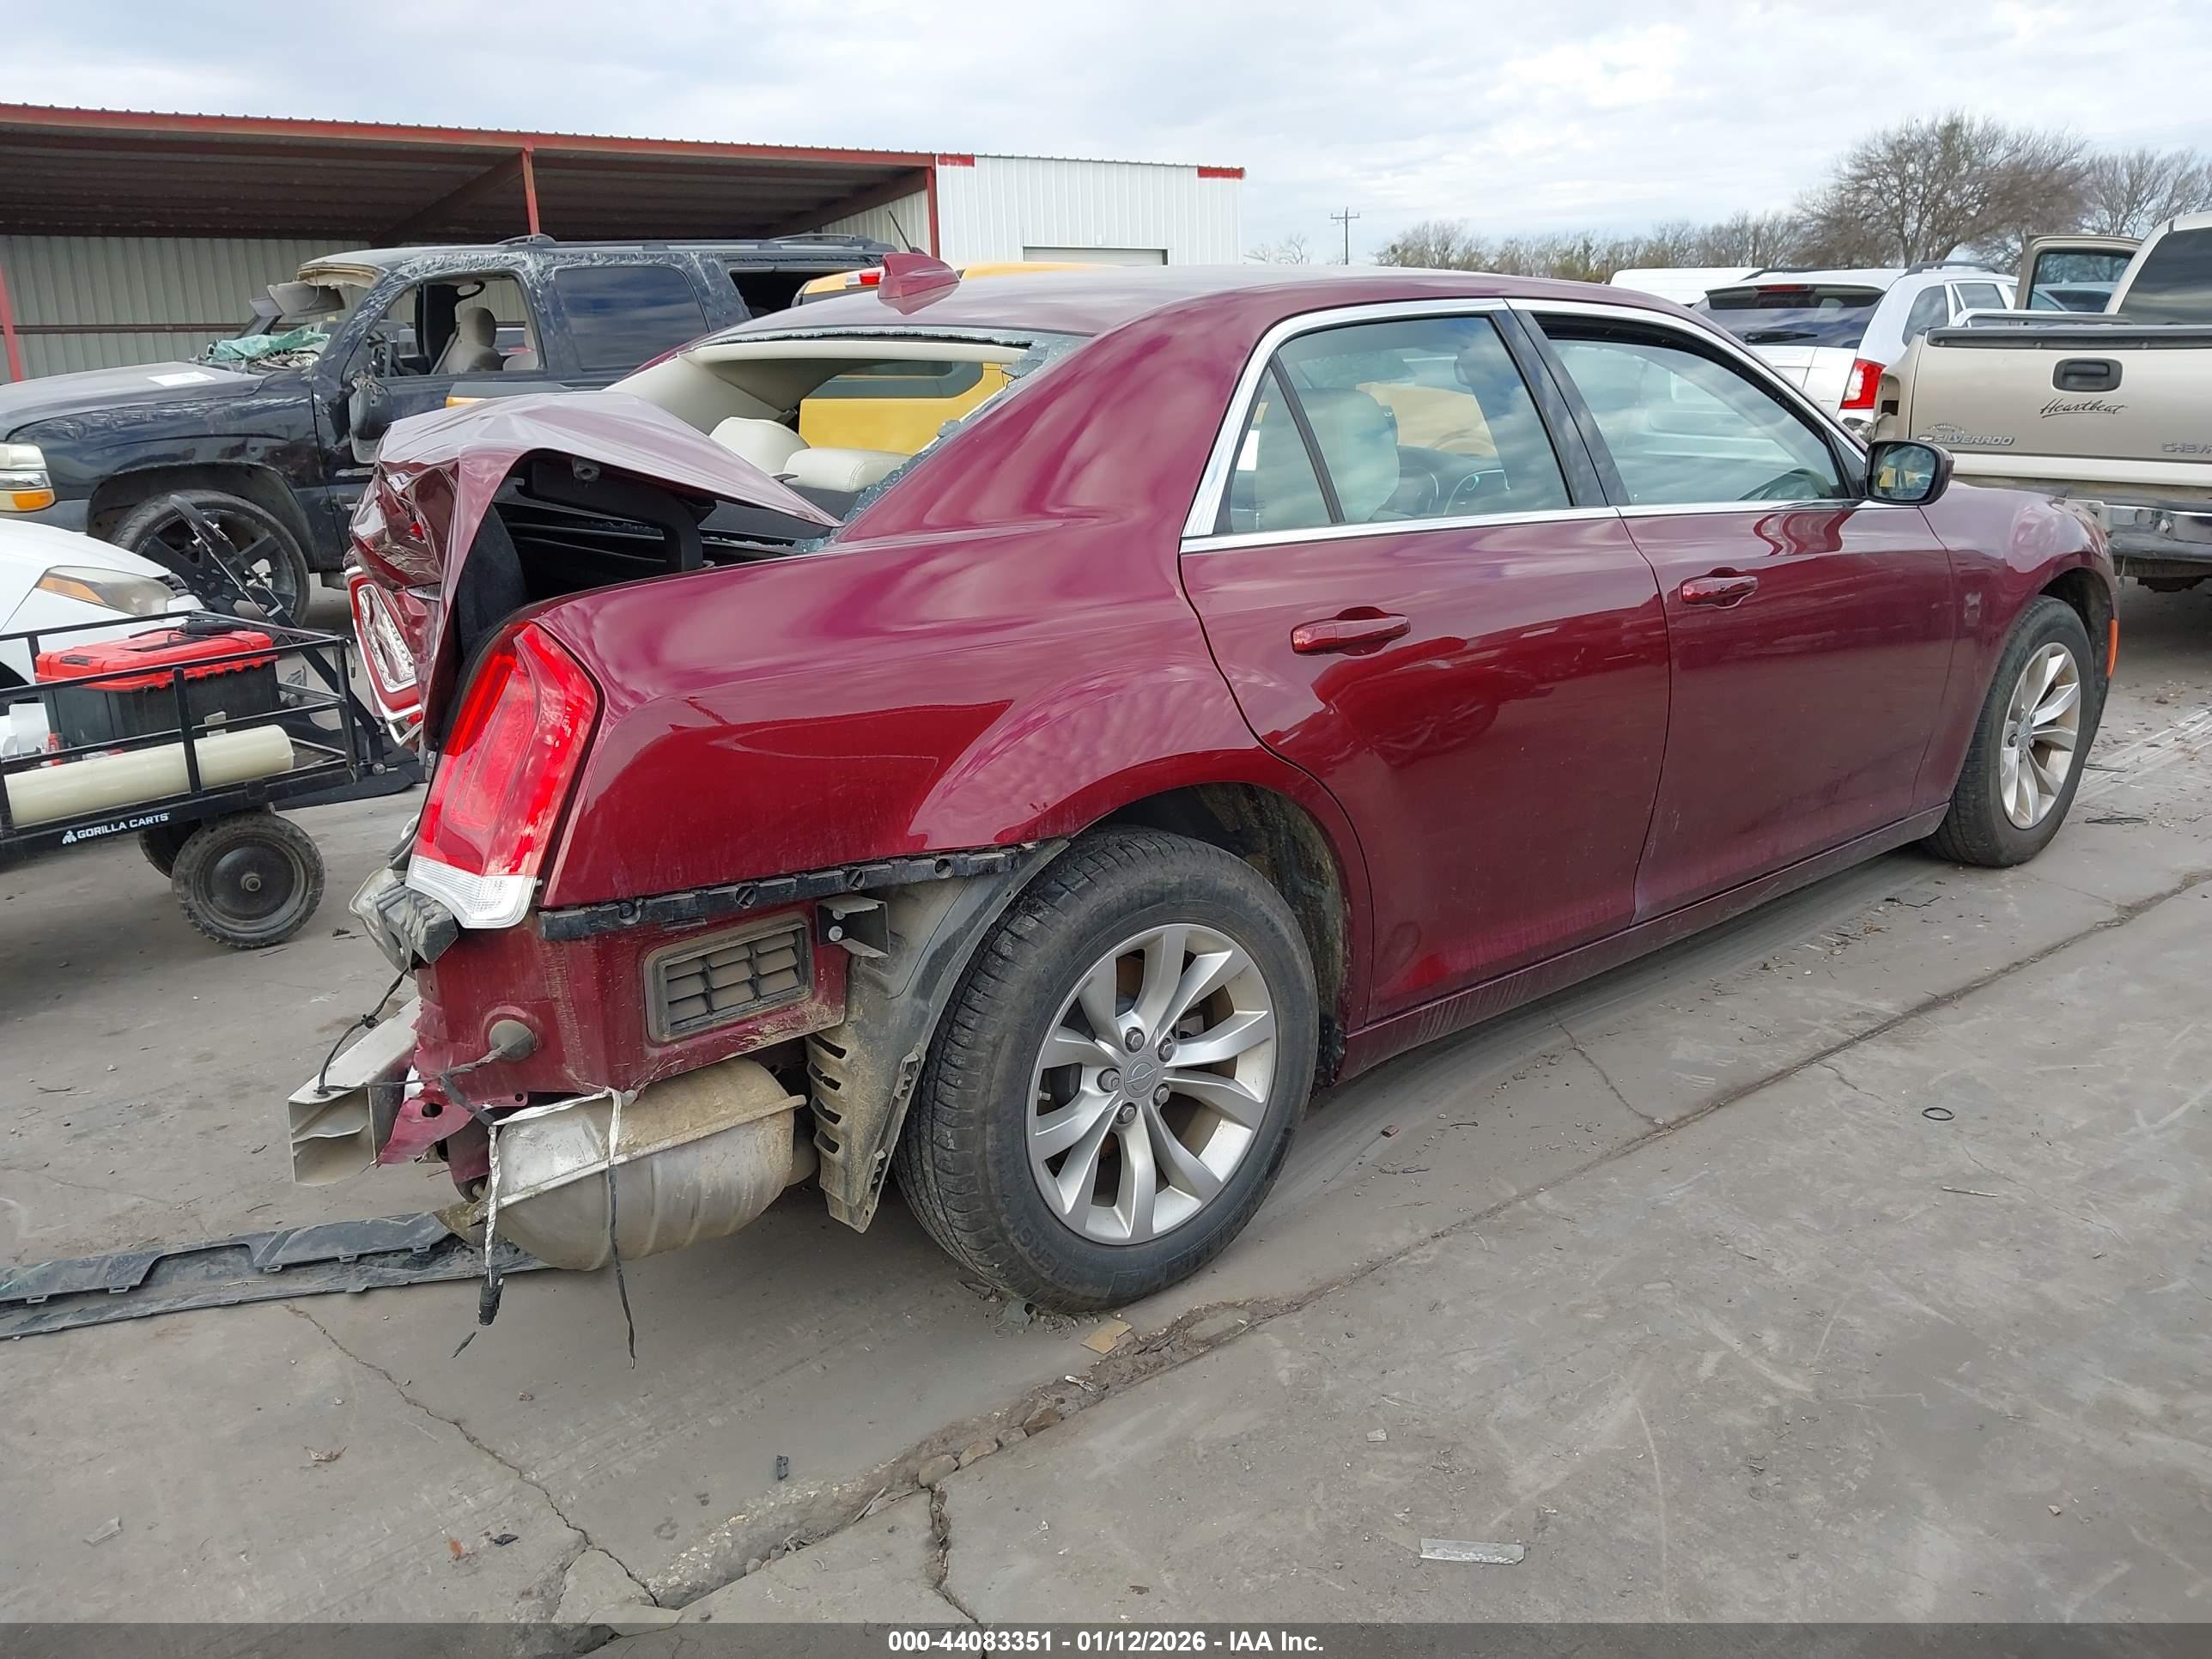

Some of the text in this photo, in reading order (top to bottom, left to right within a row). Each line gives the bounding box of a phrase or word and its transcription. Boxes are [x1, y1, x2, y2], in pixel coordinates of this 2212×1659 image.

[2039, 398, 2127, 418] Heartbeat
[1934, 434, 2015, 446] SILVERADO
[76, 812, 169, 839] GORILLA CARTS
